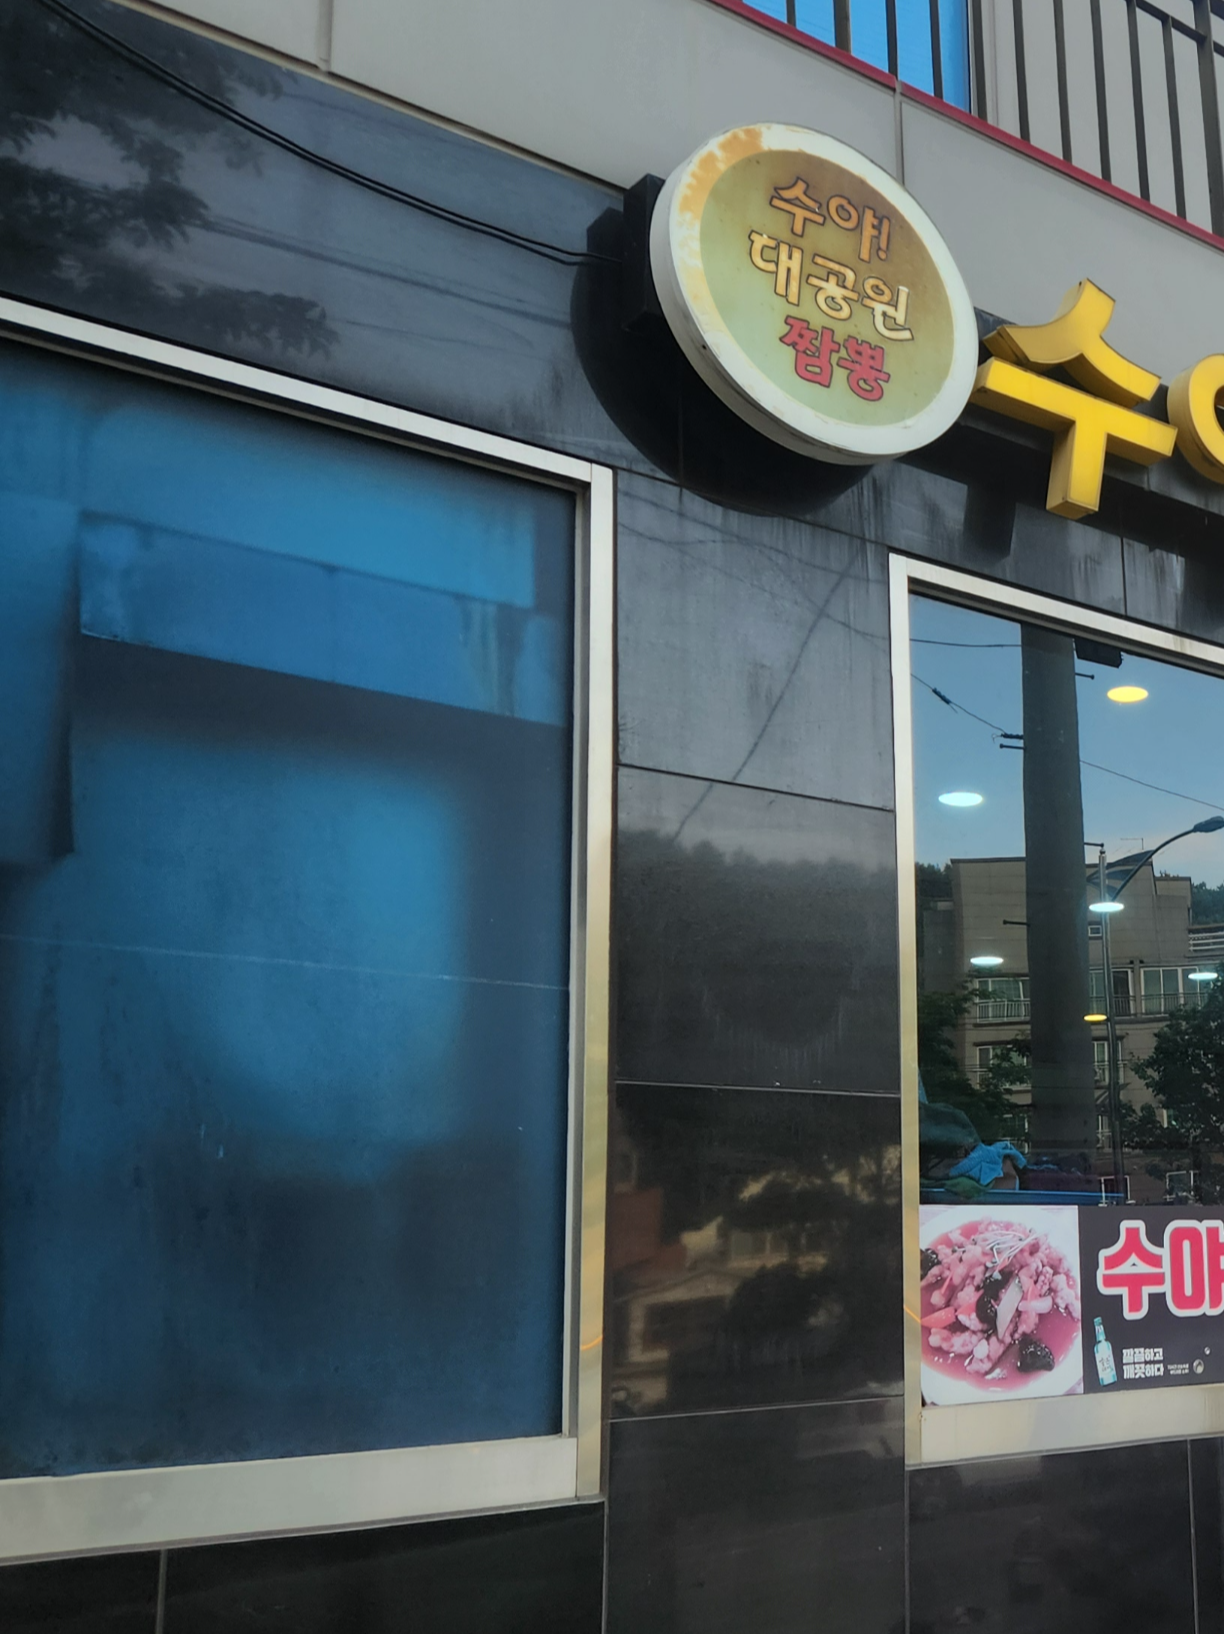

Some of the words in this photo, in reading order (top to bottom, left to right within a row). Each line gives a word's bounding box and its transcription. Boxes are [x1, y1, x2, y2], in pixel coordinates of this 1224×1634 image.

[770, 176, 891, 263] 수야!
[748, 229, 915, 342] 대공원
[778, 314, 891, 402] 짬뽕
